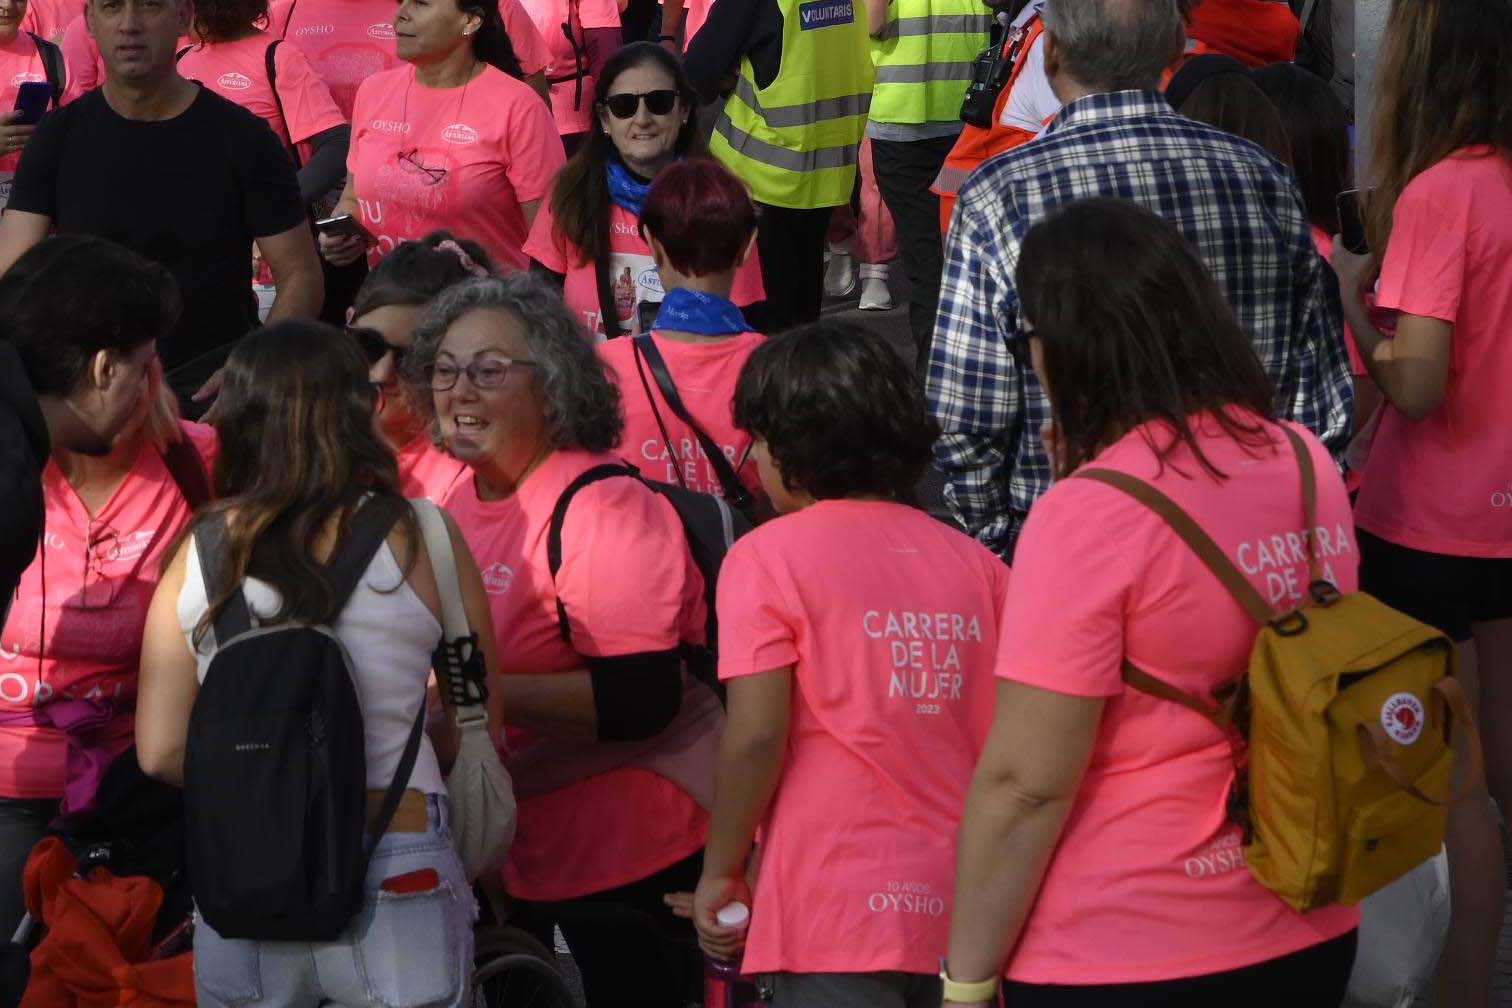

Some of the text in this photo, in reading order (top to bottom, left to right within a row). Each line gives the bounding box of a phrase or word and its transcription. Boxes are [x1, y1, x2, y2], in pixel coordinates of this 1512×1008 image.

[801, 3, 852, 23] VOLUNTARIS
[296, 25, 335, 37] OYSHO
[372, 120, 411, 134] OYSHO
[357, 199, 383, 222] TU
[1237, 524, 1352, 576] CARRRA
[1266, 571, 1299, 602] DE
[862, 610, 982, 643] CARRERA
[891, 641, 961, 671] DE LA
[888, 671, 963, 700] MUJER
[1185, 847, 1245, 878] OYSH
[869, 892, 945, 918] OYSHO
